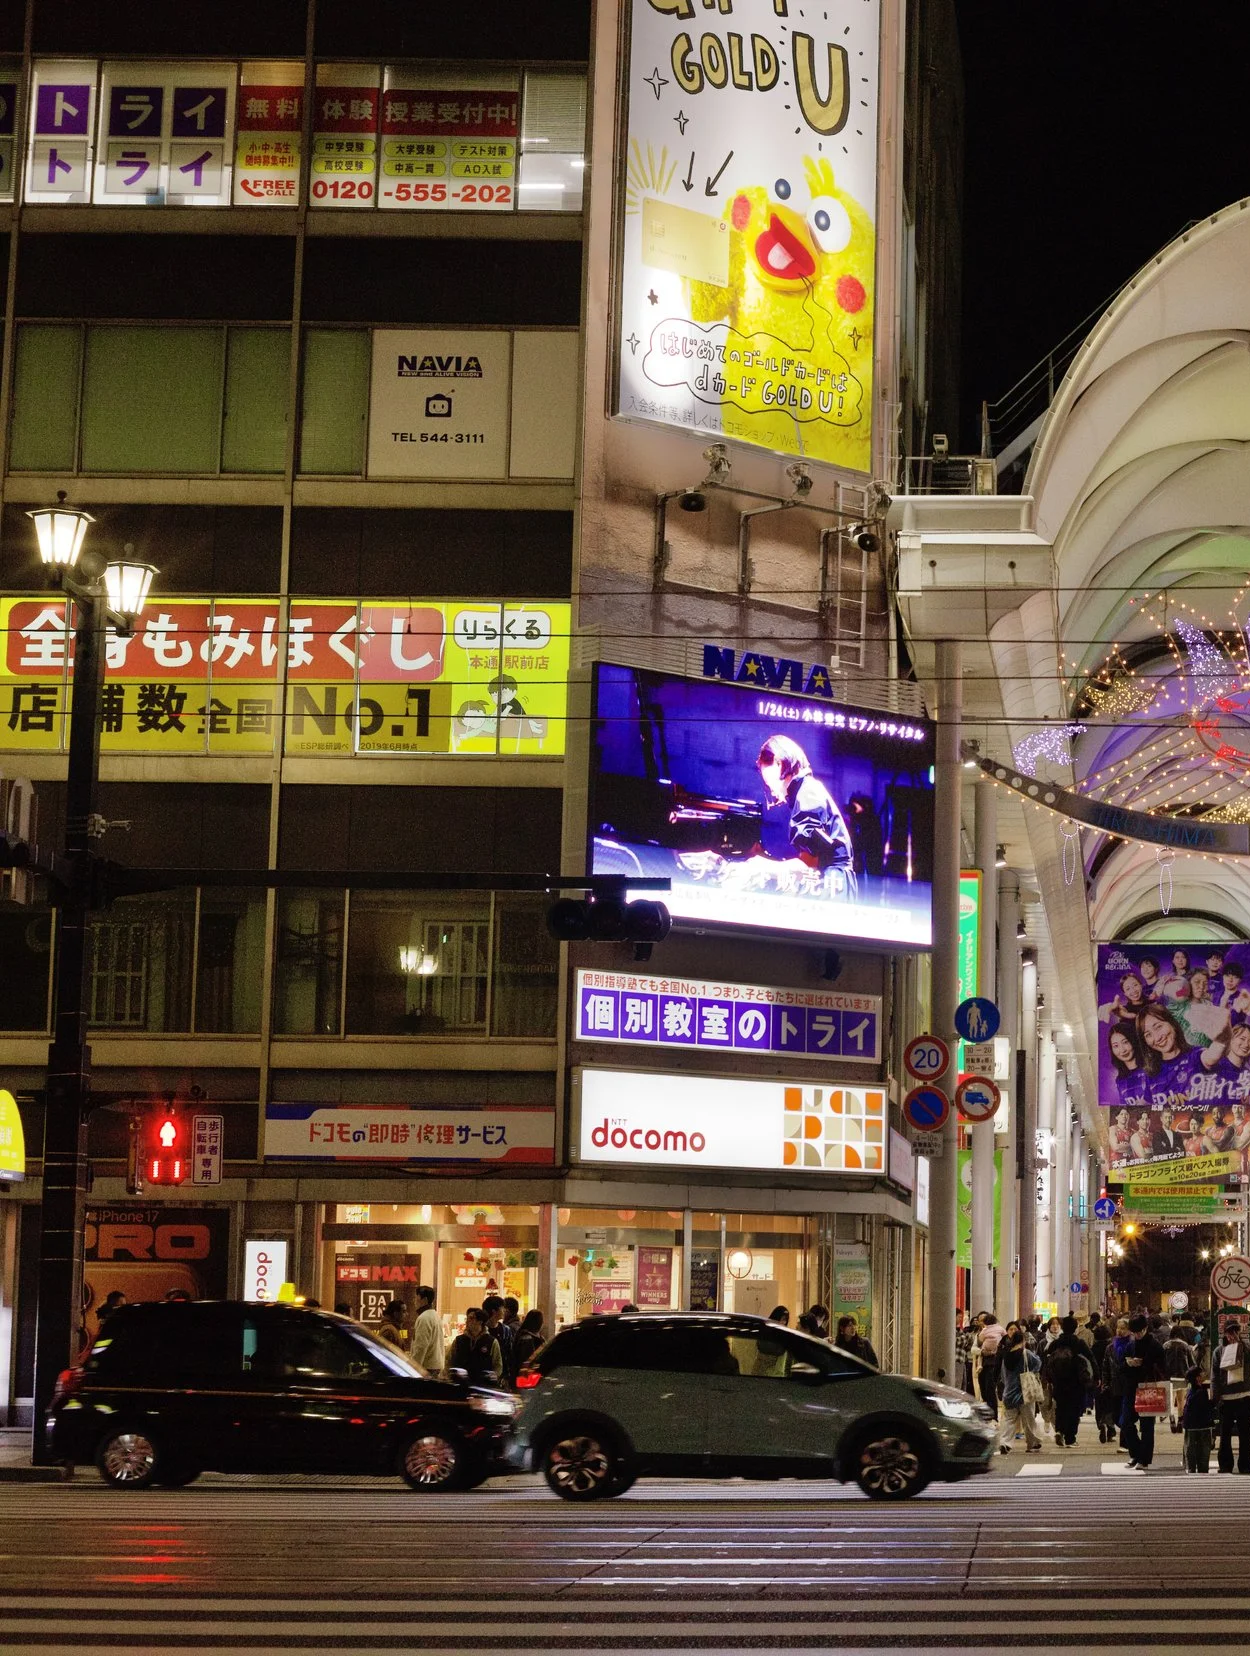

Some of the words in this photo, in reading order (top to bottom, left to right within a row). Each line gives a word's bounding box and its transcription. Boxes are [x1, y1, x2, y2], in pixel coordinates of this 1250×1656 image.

[671, 32, 780, 94] GOLD
[791, 31, 850, 136] U
[54, 91, 215, 131] トライ
[48, 148, 213, 187] トライ
[324, 160, 364, 170] 高校受験
[253, 180, 295, 189] FREE
[398, 355, 482, 371] NAVIA
[660, 332, 848, 393] はじめてのゴールドカードは
[695, 364, 756, 398] dカード
[763, 381, 813, 410] GOLD
[392, 433, 416, 442] TEL
[463, 618, 541, 641] りらくる
[469, 655, 550, 671] 本通駅前店
[703, 645, 834, 697] NAVIA
[291, 686, 431, 737] No.1
[585, 994, 870, 1051] 個別教室のトライ
[914, 1048, 940, 1069] 20
[611, 1118, 628, 1126] NTT
[208, 1120, 219, 1155] 歩行者
[591, 1118, 706, 1153] docomo
[100, 1211, 145, 1222] iPhone
[145, 1211, 160, 1222] 17
[340, 1268, 369, 1279] ドコモ
[372, 1265, 418, 1282] MAX
[368, 1295, 387, 1306] DA
